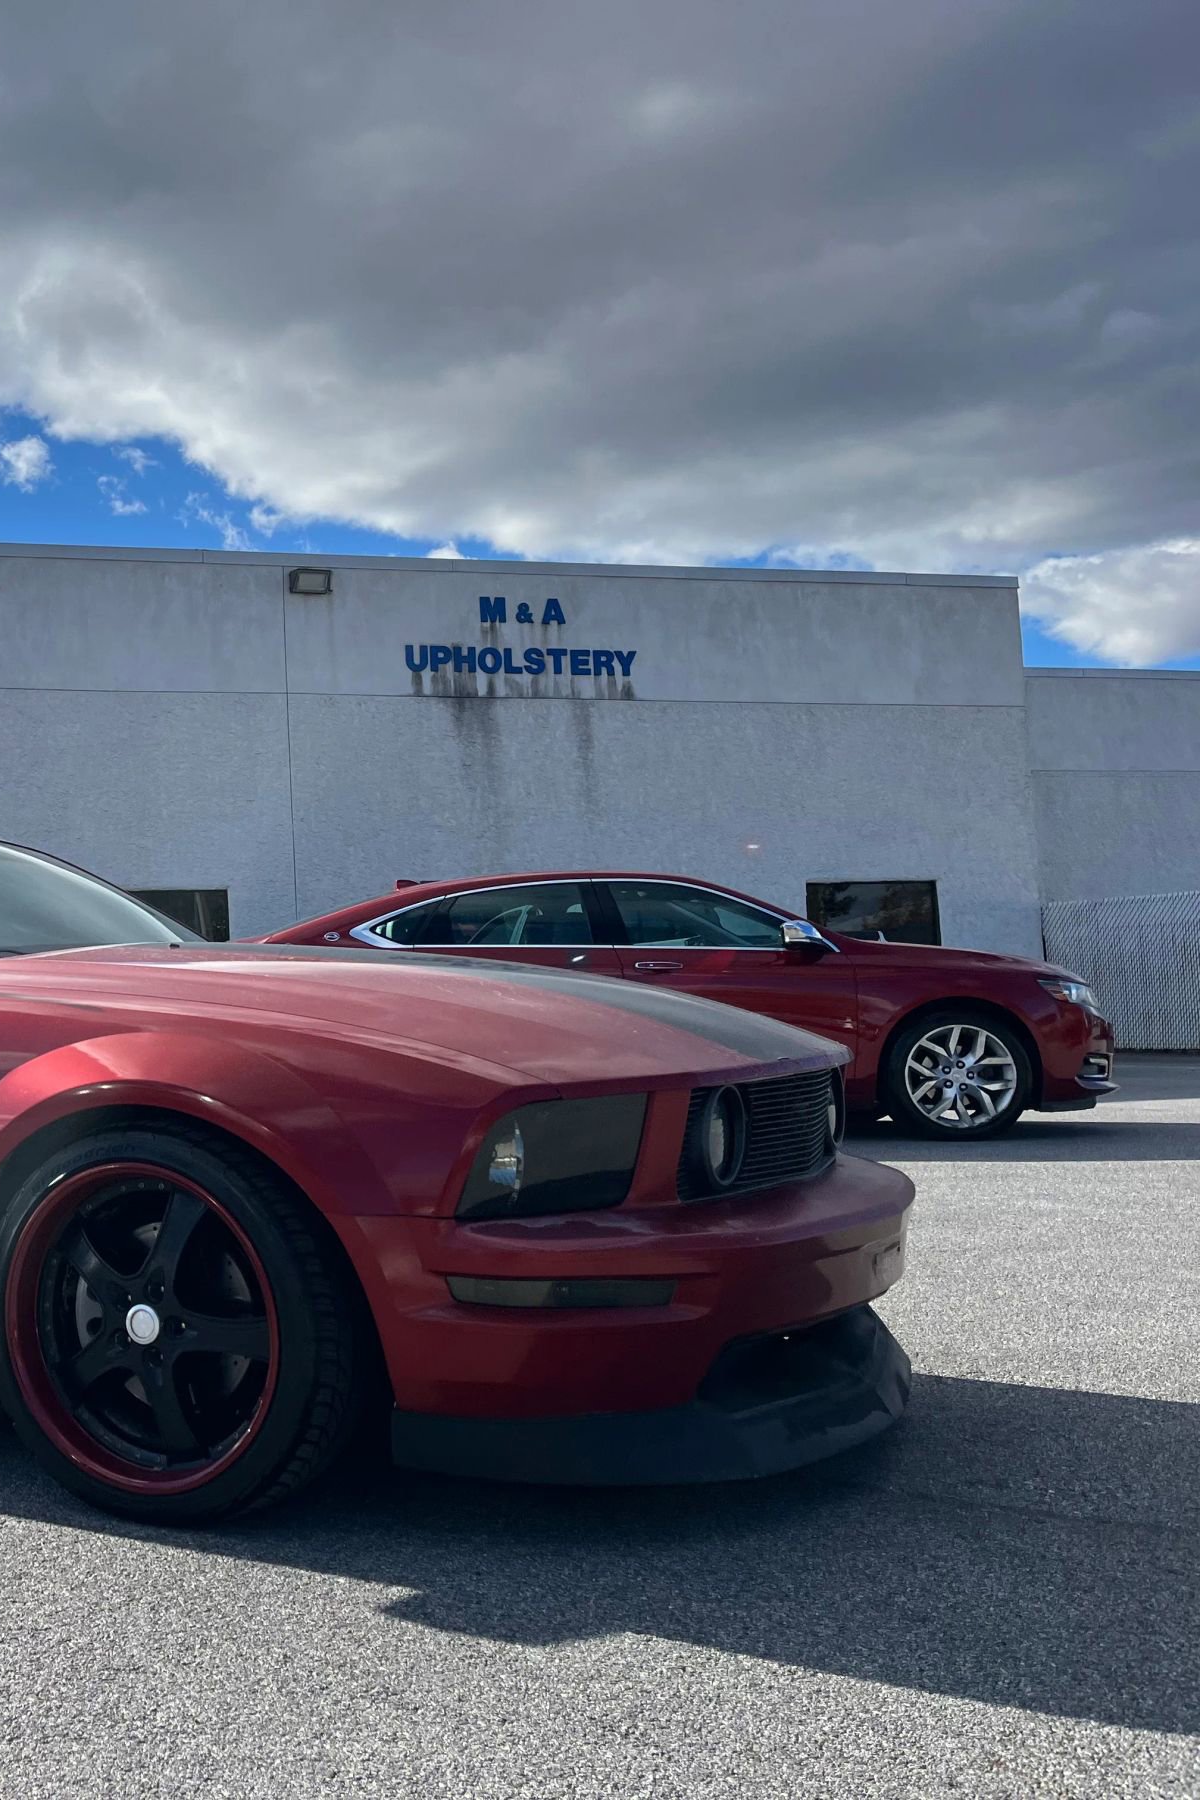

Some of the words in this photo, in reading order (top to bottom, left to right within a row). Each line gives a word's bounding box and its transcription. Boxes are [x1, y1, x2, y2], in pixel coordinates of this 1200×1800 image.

[479, 596, 507, 623] M
[515, 602, 535, 624] &
[541, 598, 566, 625] A
[405, 644, 637, 677] UPHOLSTERY
